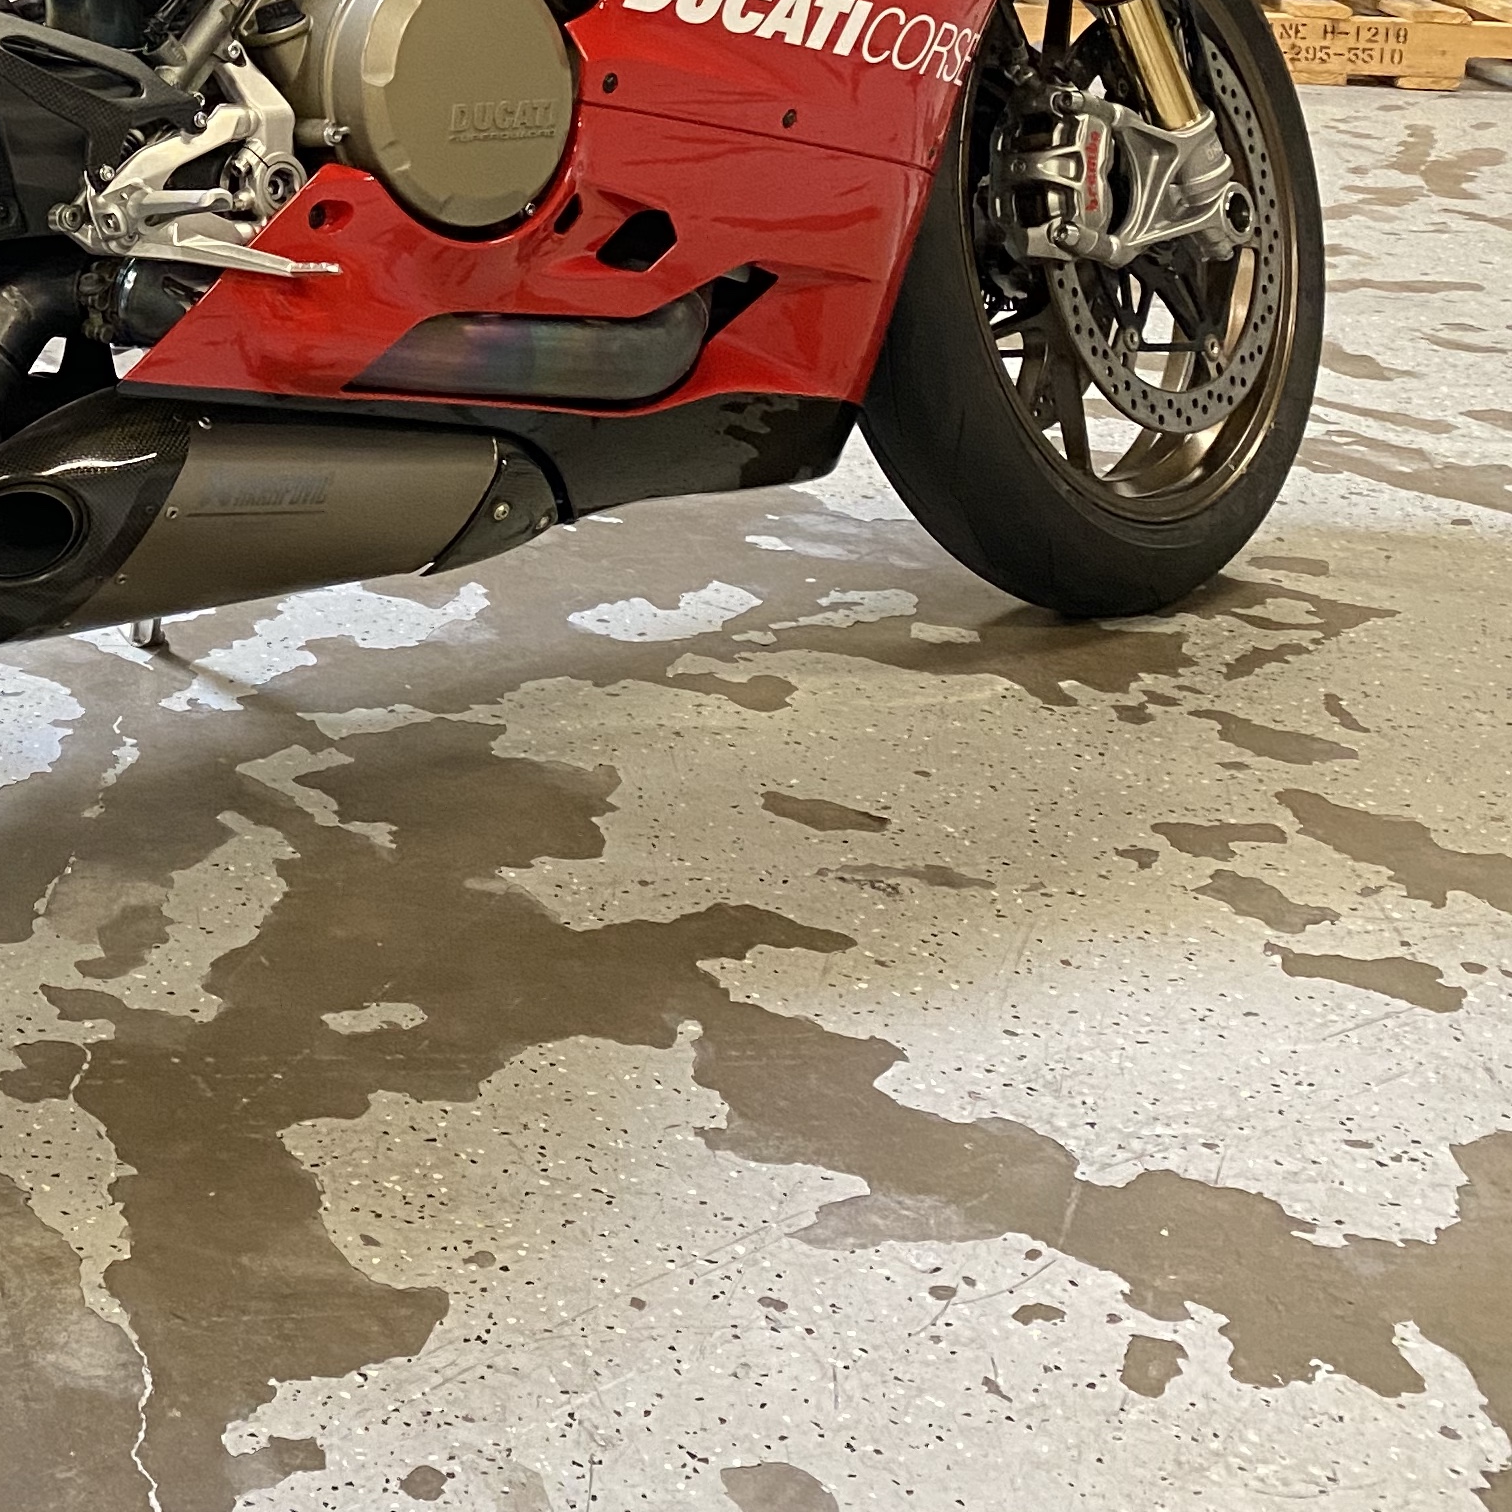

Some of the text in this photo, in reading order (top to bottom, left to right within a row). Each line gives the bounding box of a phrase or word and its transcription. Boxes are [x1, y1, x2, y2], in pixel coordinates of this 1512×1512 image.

[861, 7, 981, 86] CORSE
[1269, 23, 1308, 40] NE
[450, 100, 557, 132] DUCATI
